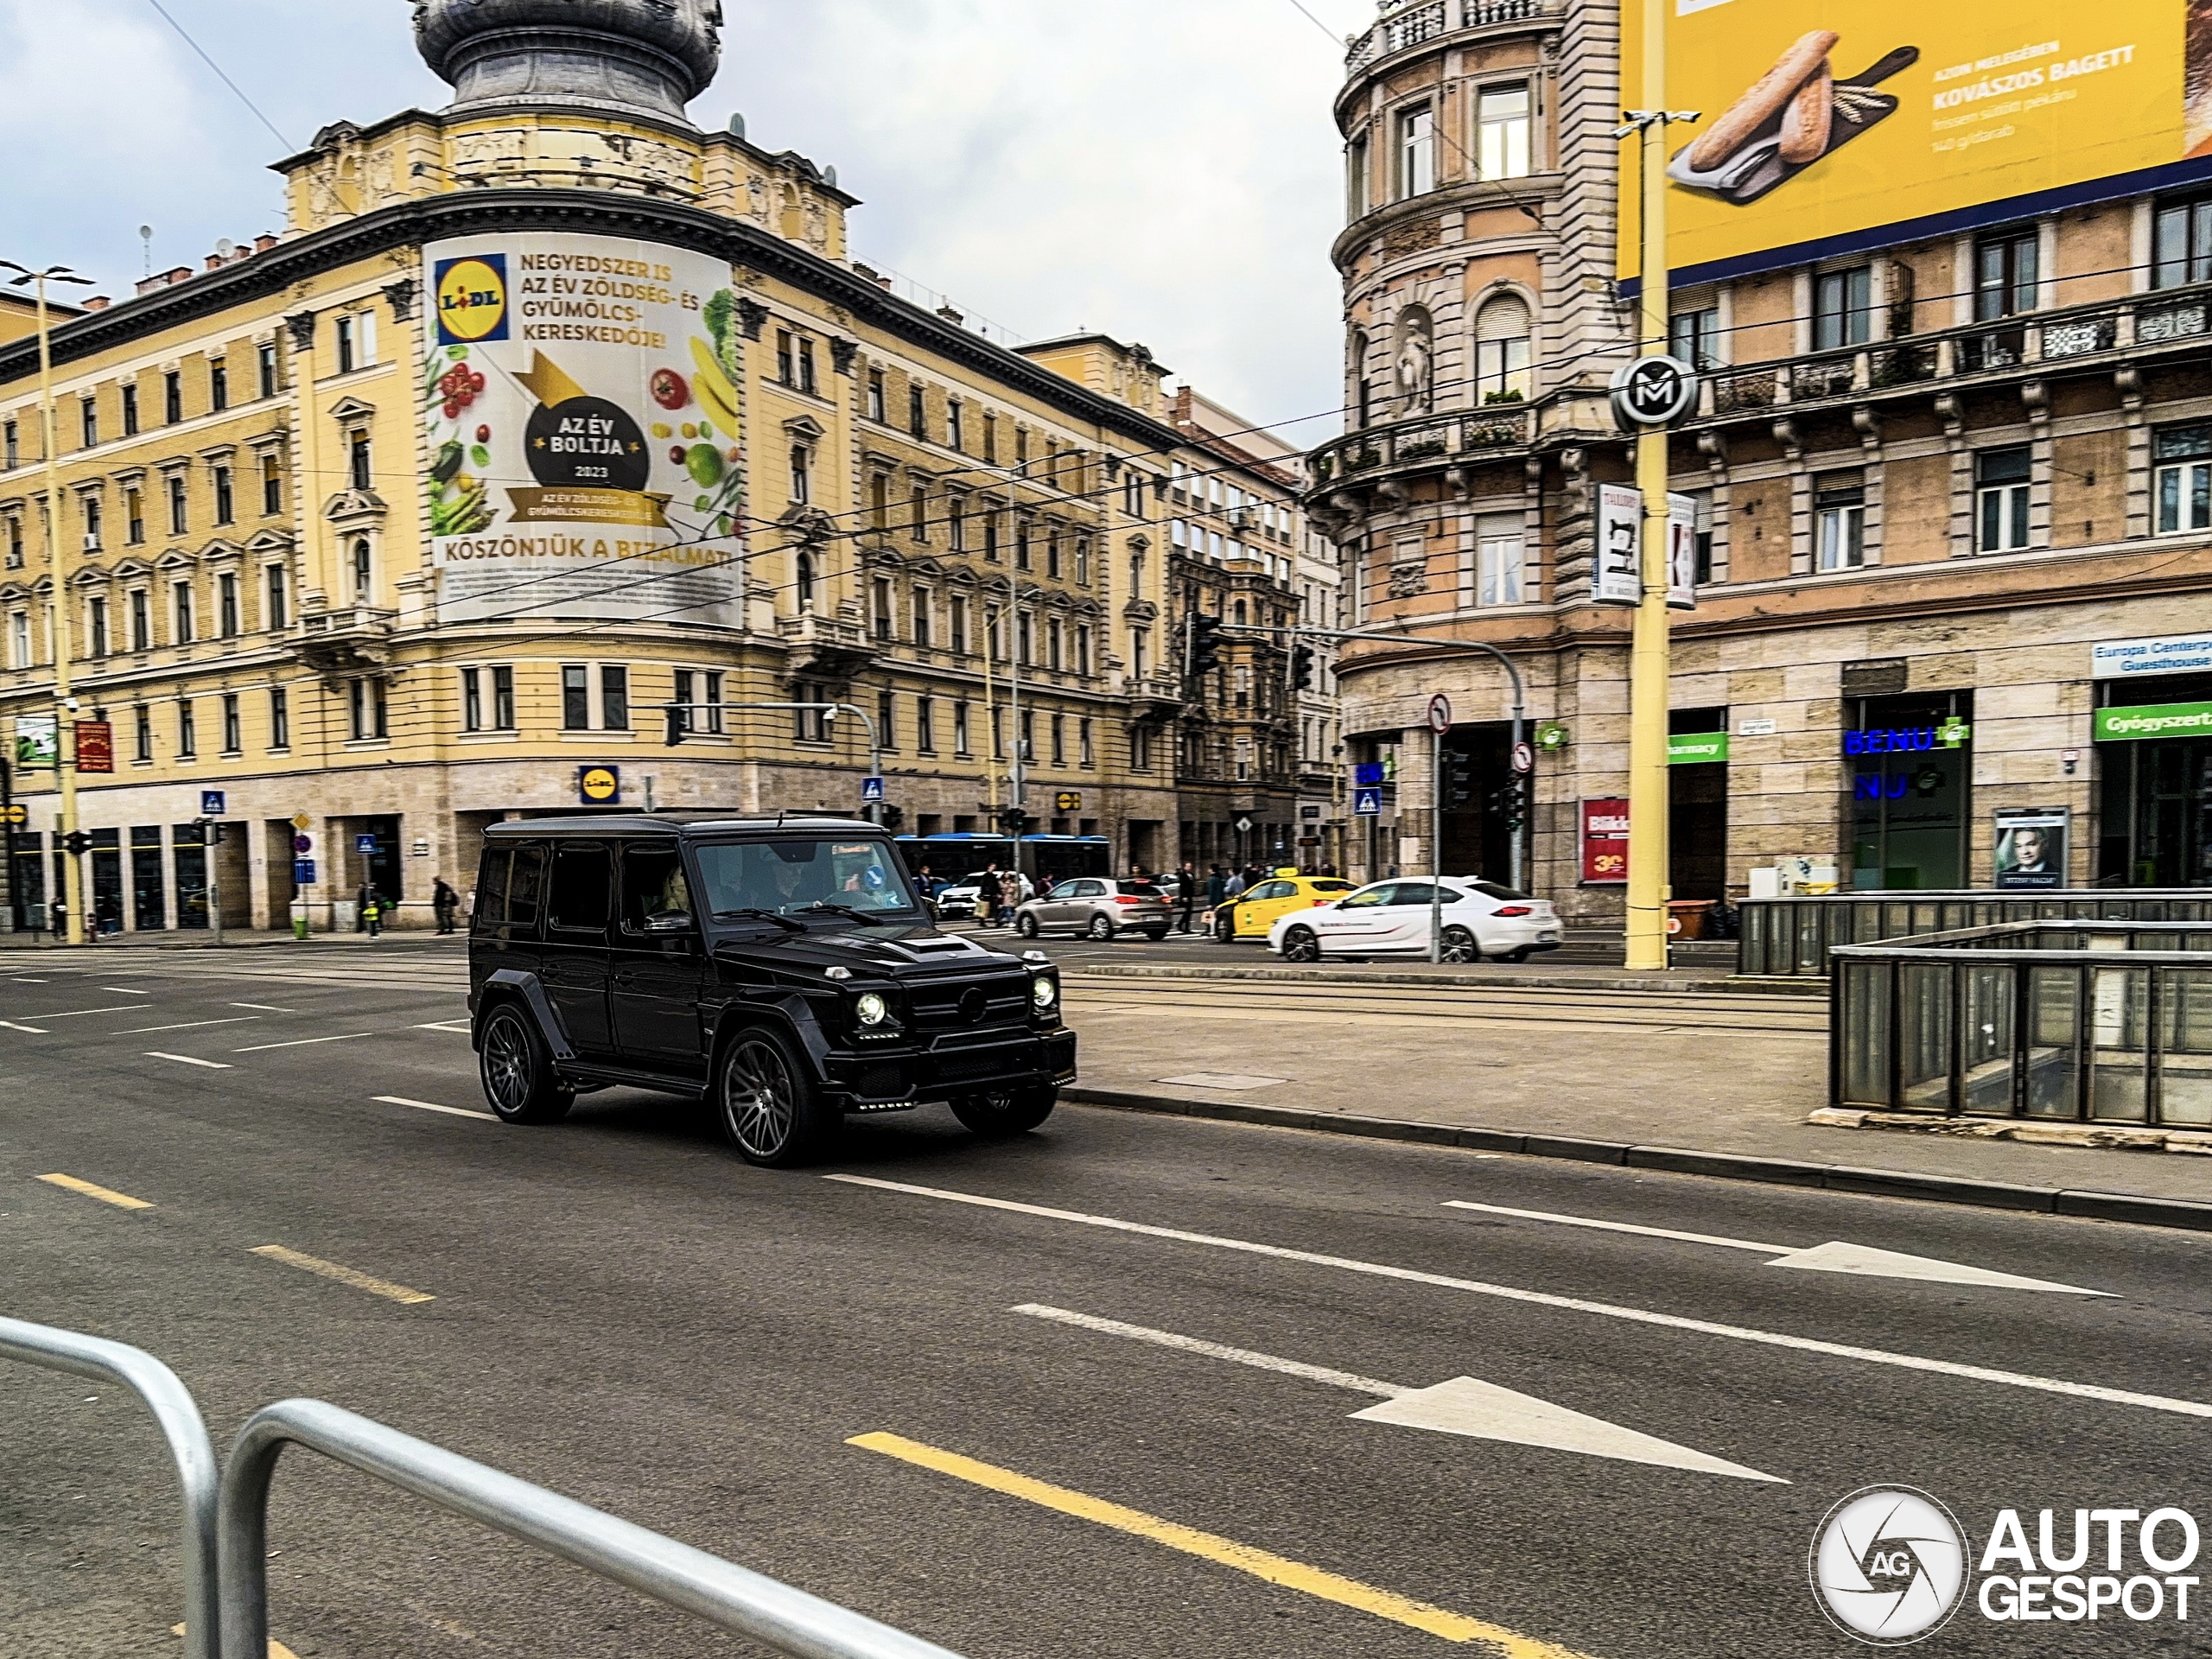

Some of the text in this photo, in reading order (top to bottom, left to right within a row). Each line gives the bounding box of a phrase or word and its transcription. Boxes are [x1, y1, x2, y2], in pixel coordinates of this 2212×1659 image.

[1933, 45, 2136, 111] KOVÁSZOS BAGETT
[520, 253, 673, 282] NEGYEDSZER IS
[521, 274, 699, 311] AZ ÉV ZÖLDSÉG- ÉS
[1637, 370, 1674, 406] M
[558, 414, 614, 435] AZ ÉV
[550, 436, 625, 455] BOLTJA
[575, 466, 608, 477] 2023
[541, 493, 556, 504] AZ
[445, 533, 733, 570] KÖSZÖNJÜK A BIZALMAT!
[2094, 646, 2147, 658] Europa
[2120, 657, 2212, 671] Guesthouse
[2106, 712, 2212, 734] Gyógyszert
[1667, 743, 1719, 755] harmacy
[1844, 727, 1934, 755] BENU
